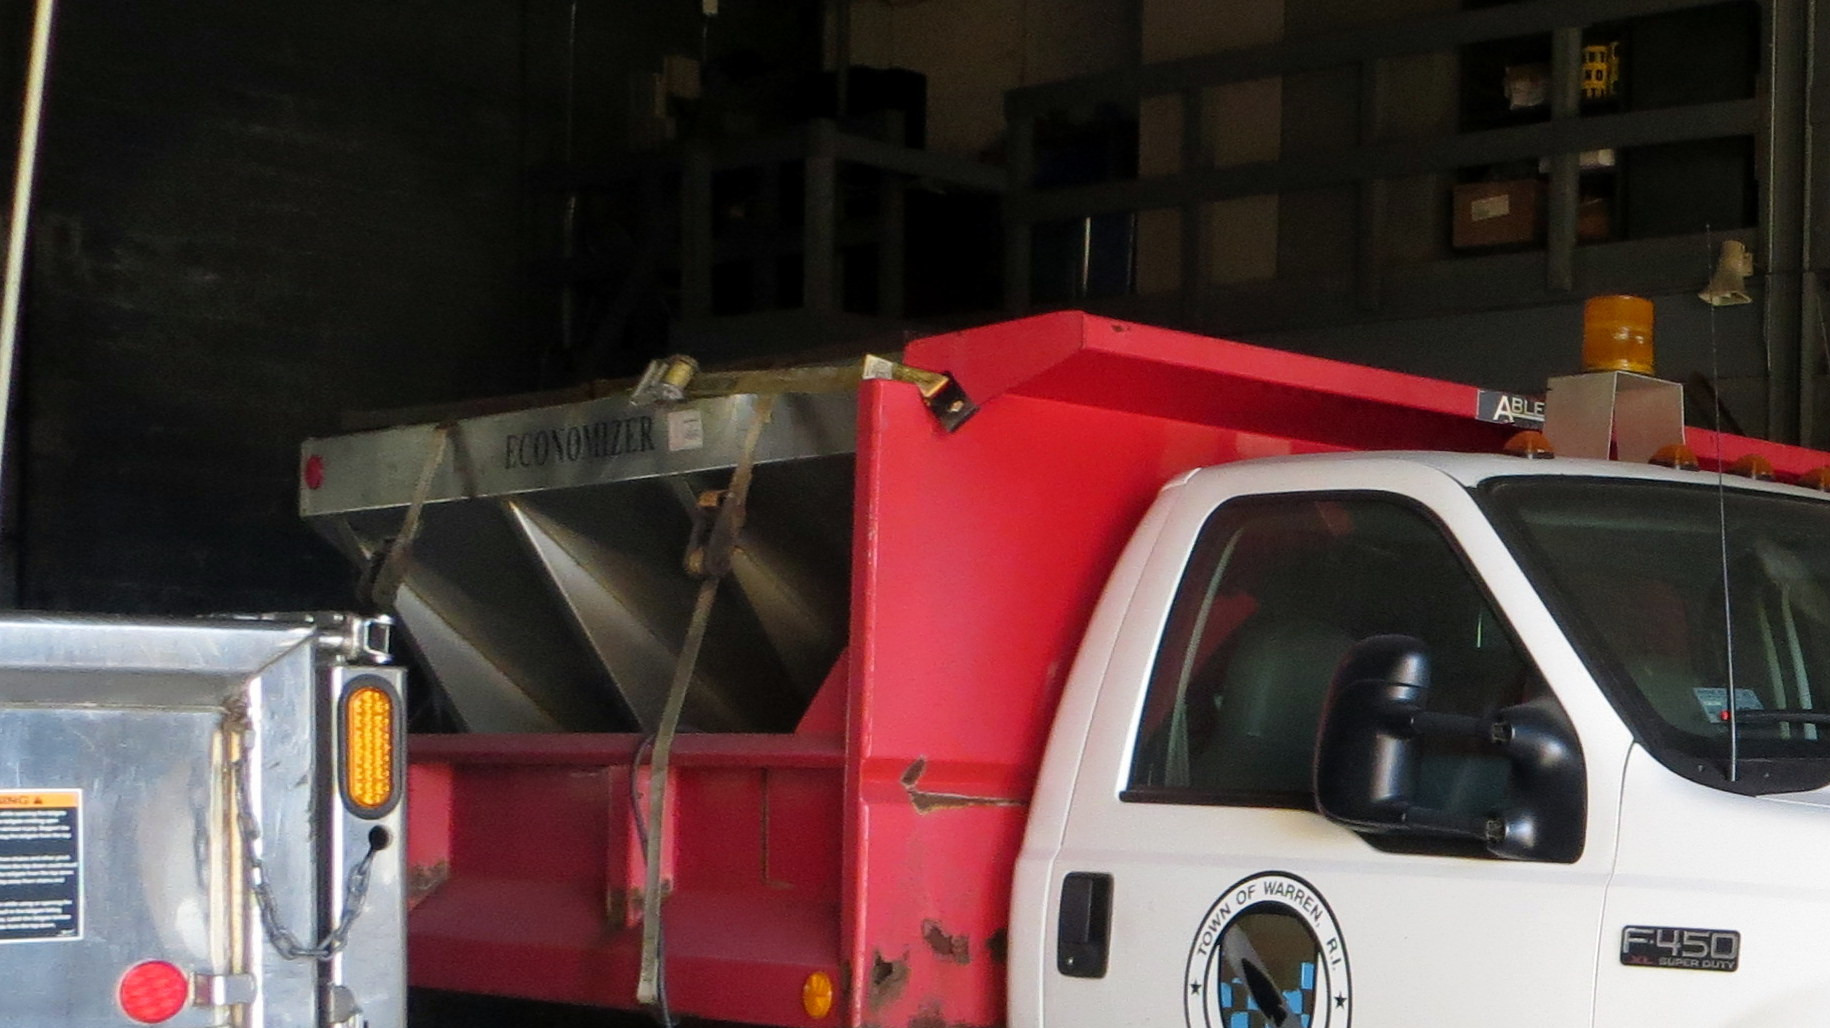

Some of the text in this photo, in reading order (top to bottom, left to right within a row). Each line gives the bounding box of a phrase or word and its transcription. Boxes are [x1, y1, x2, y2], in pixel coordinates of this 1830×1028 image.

[1493, 395, 1545, 423] ABLE
[504, 416, 655, 469] ECONOMIZER
[1197, 881, 1343, 971] TOWN OF WARREN, R.I.
[1623, 928, 1739, 959] F-450
[1659, 957, 1699, 967] SUPER
[1702, 960, 1735, 969] DUTY
